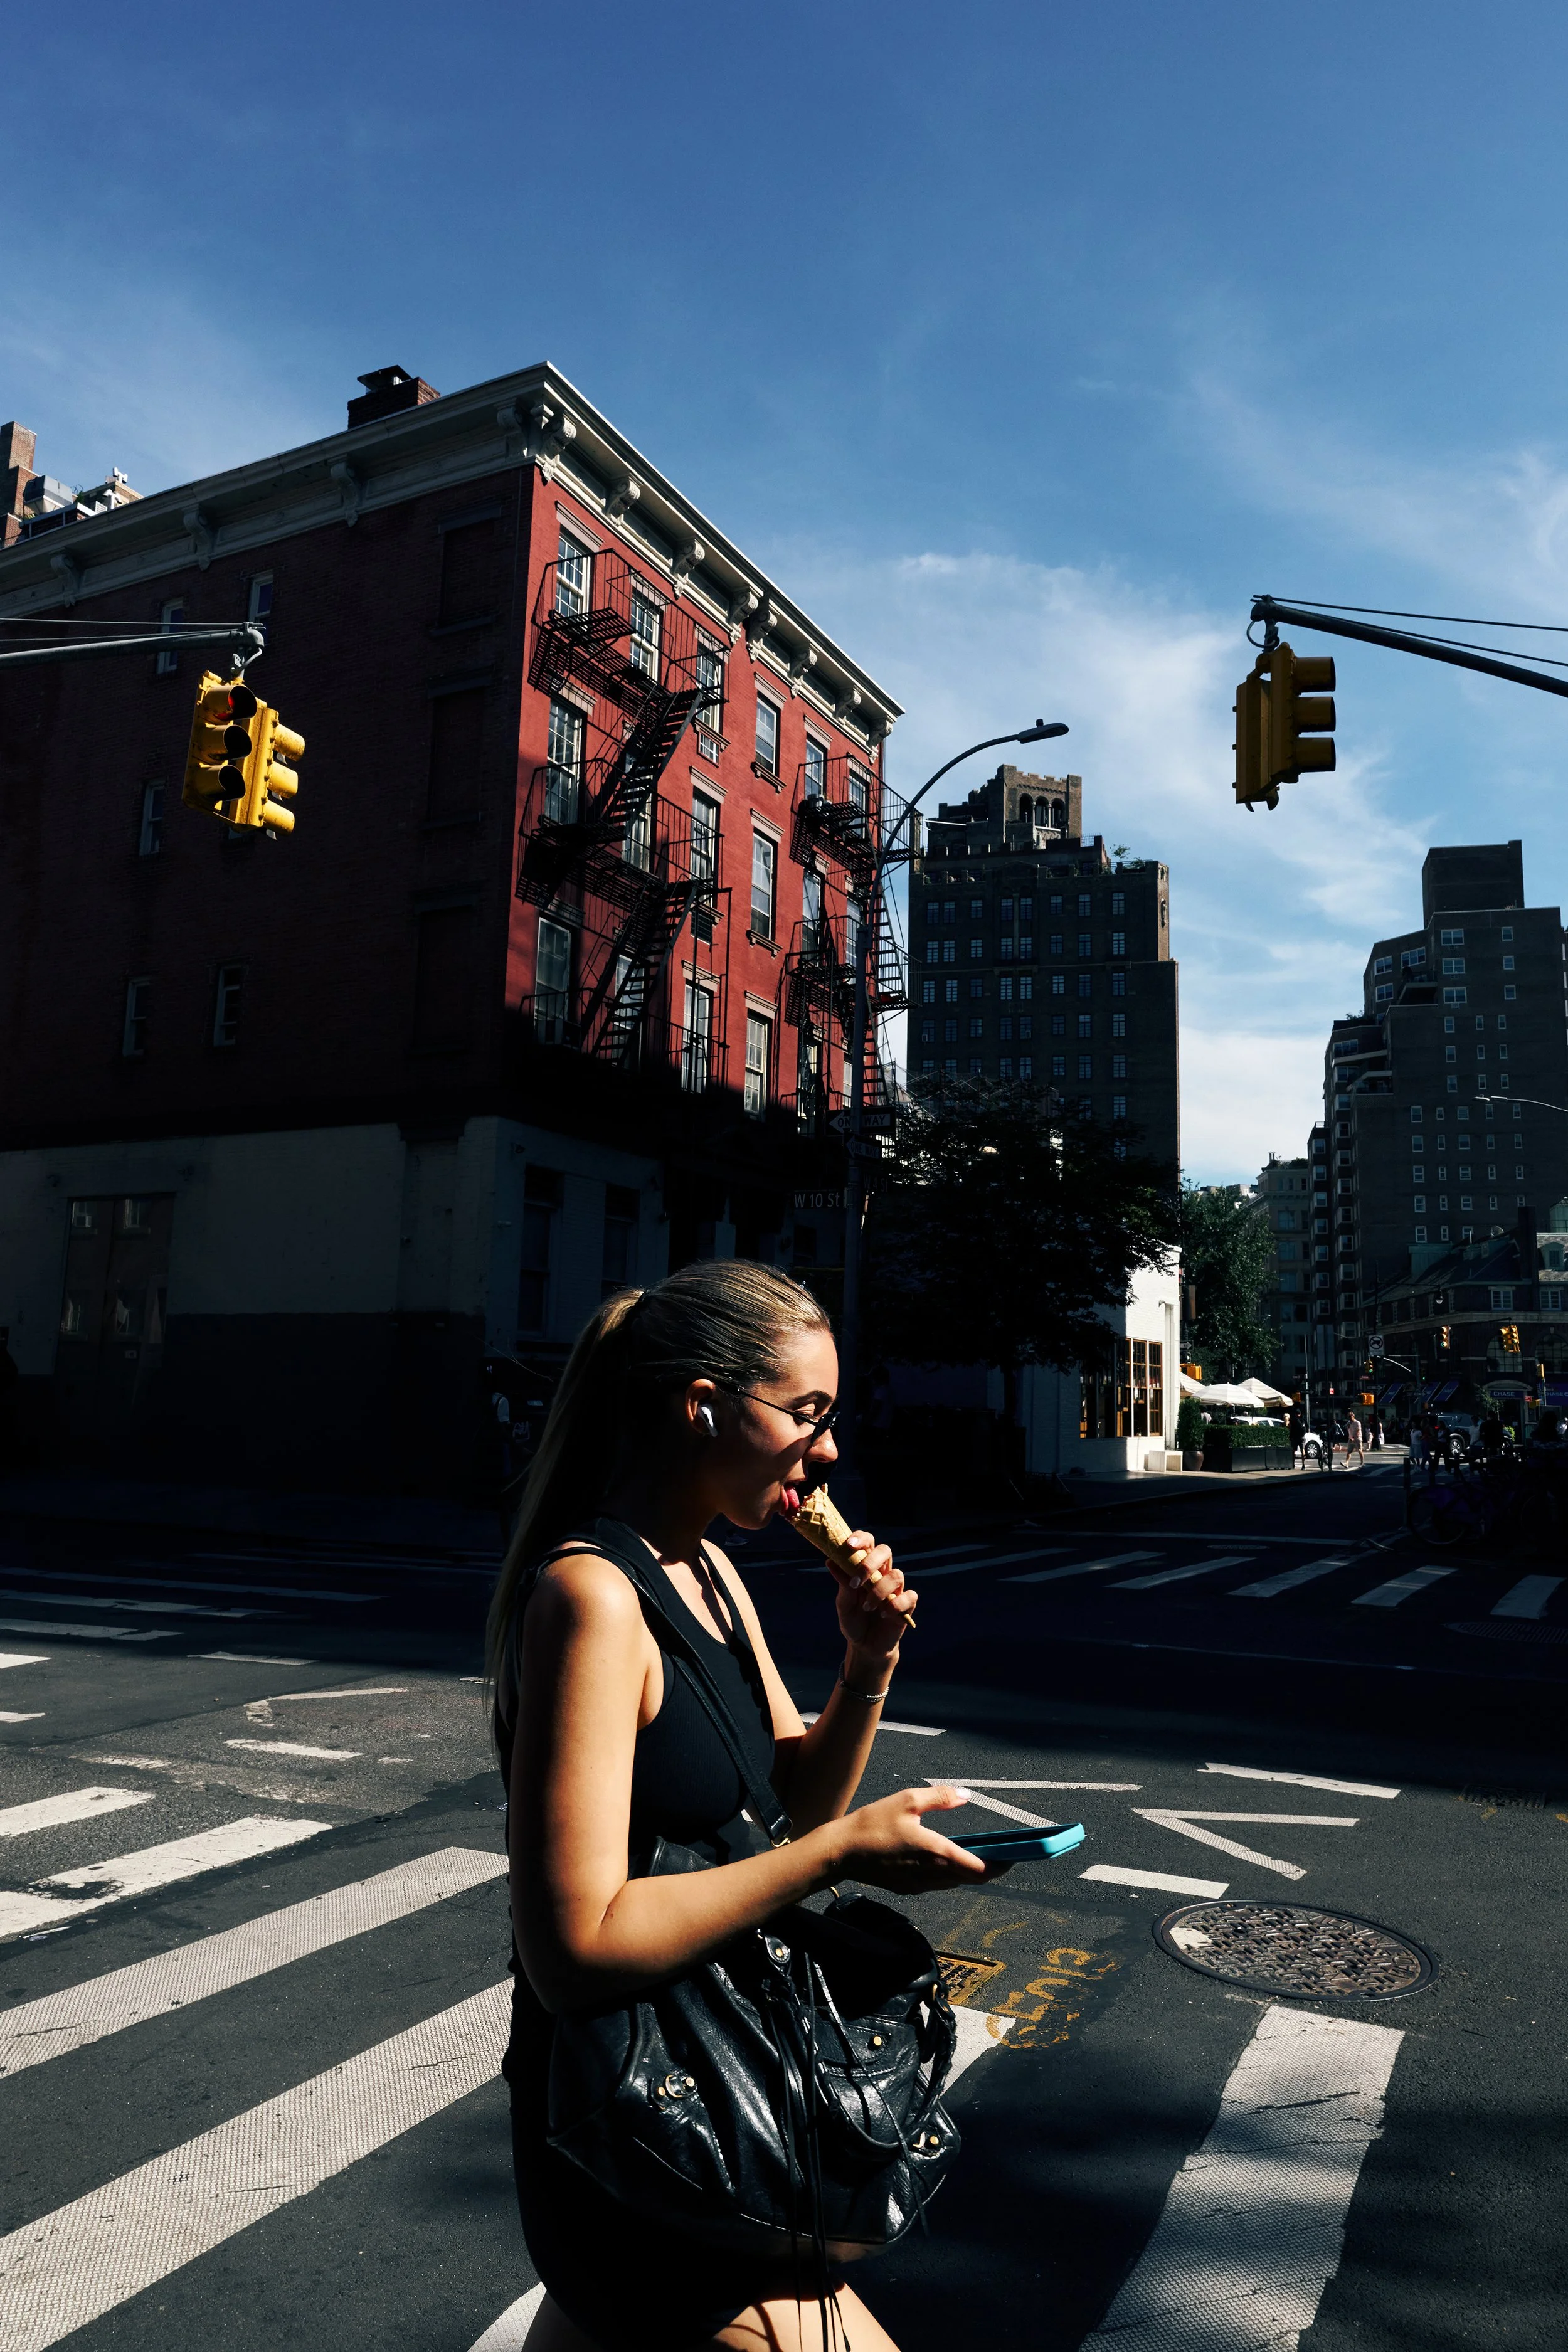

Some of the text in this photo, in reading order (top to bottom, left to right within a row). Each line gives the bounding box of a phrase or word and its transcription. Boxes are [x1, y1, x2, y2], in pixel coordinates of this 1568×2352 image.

[837, 1115, 886, 1128] ON WAY
[850, 1141, 877, 1157] ONE WAY
[863, 1173, 889, 1193] W 4 St
[794, 1192, 840, 1209] W 10 St
